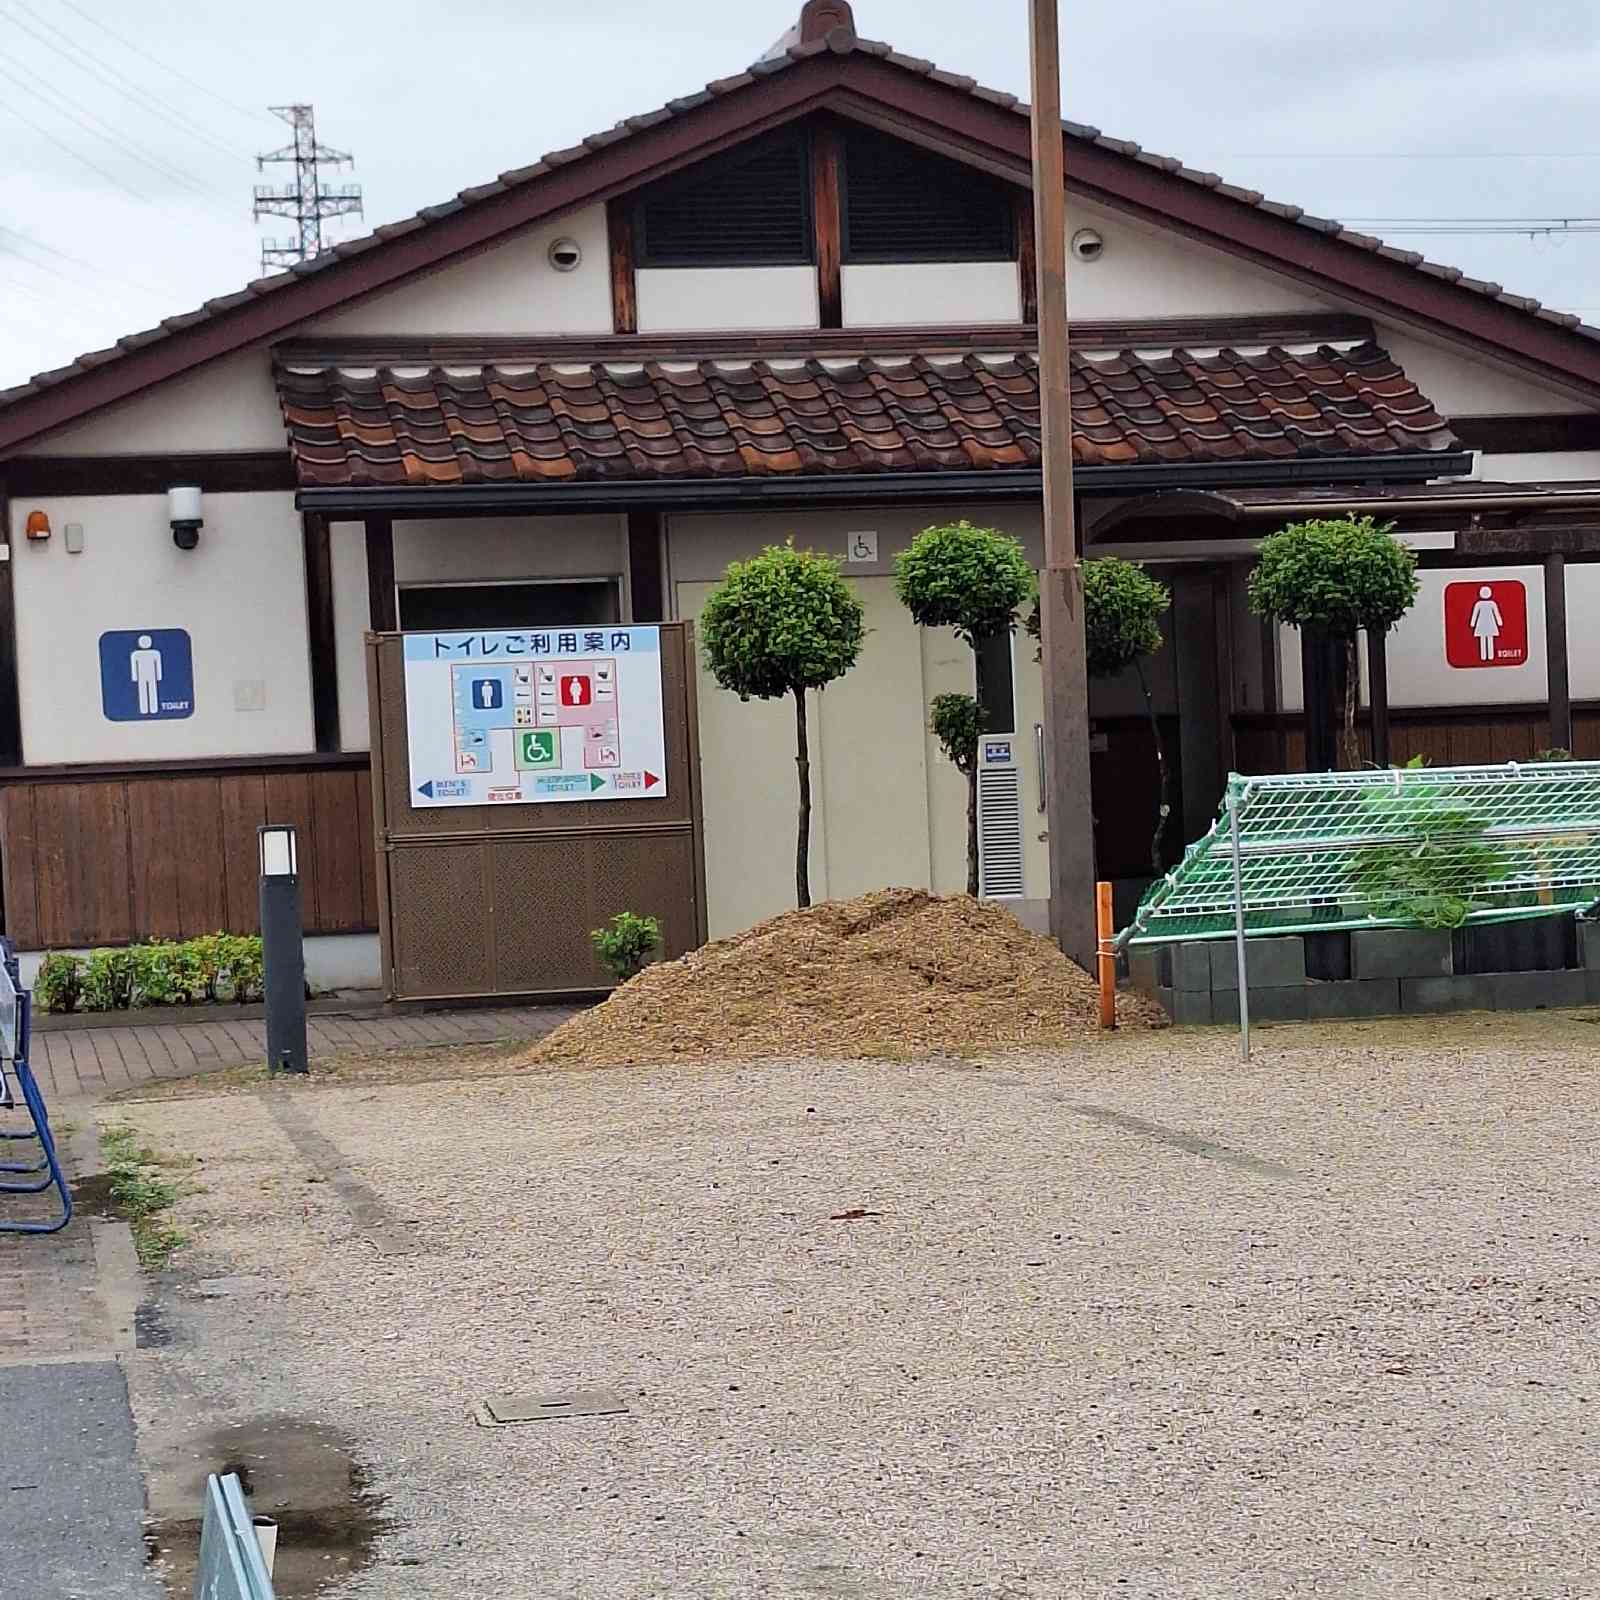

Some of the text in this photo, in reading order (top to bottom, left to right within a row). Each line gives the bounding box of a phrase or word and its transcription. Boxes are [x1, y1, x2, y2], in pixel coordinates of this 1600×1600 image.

[434, 632, 631, 658] トイレご利用案内
[1497, 649, 1522, 658] TOILET
[161, 701, 189, 710] TOILET
